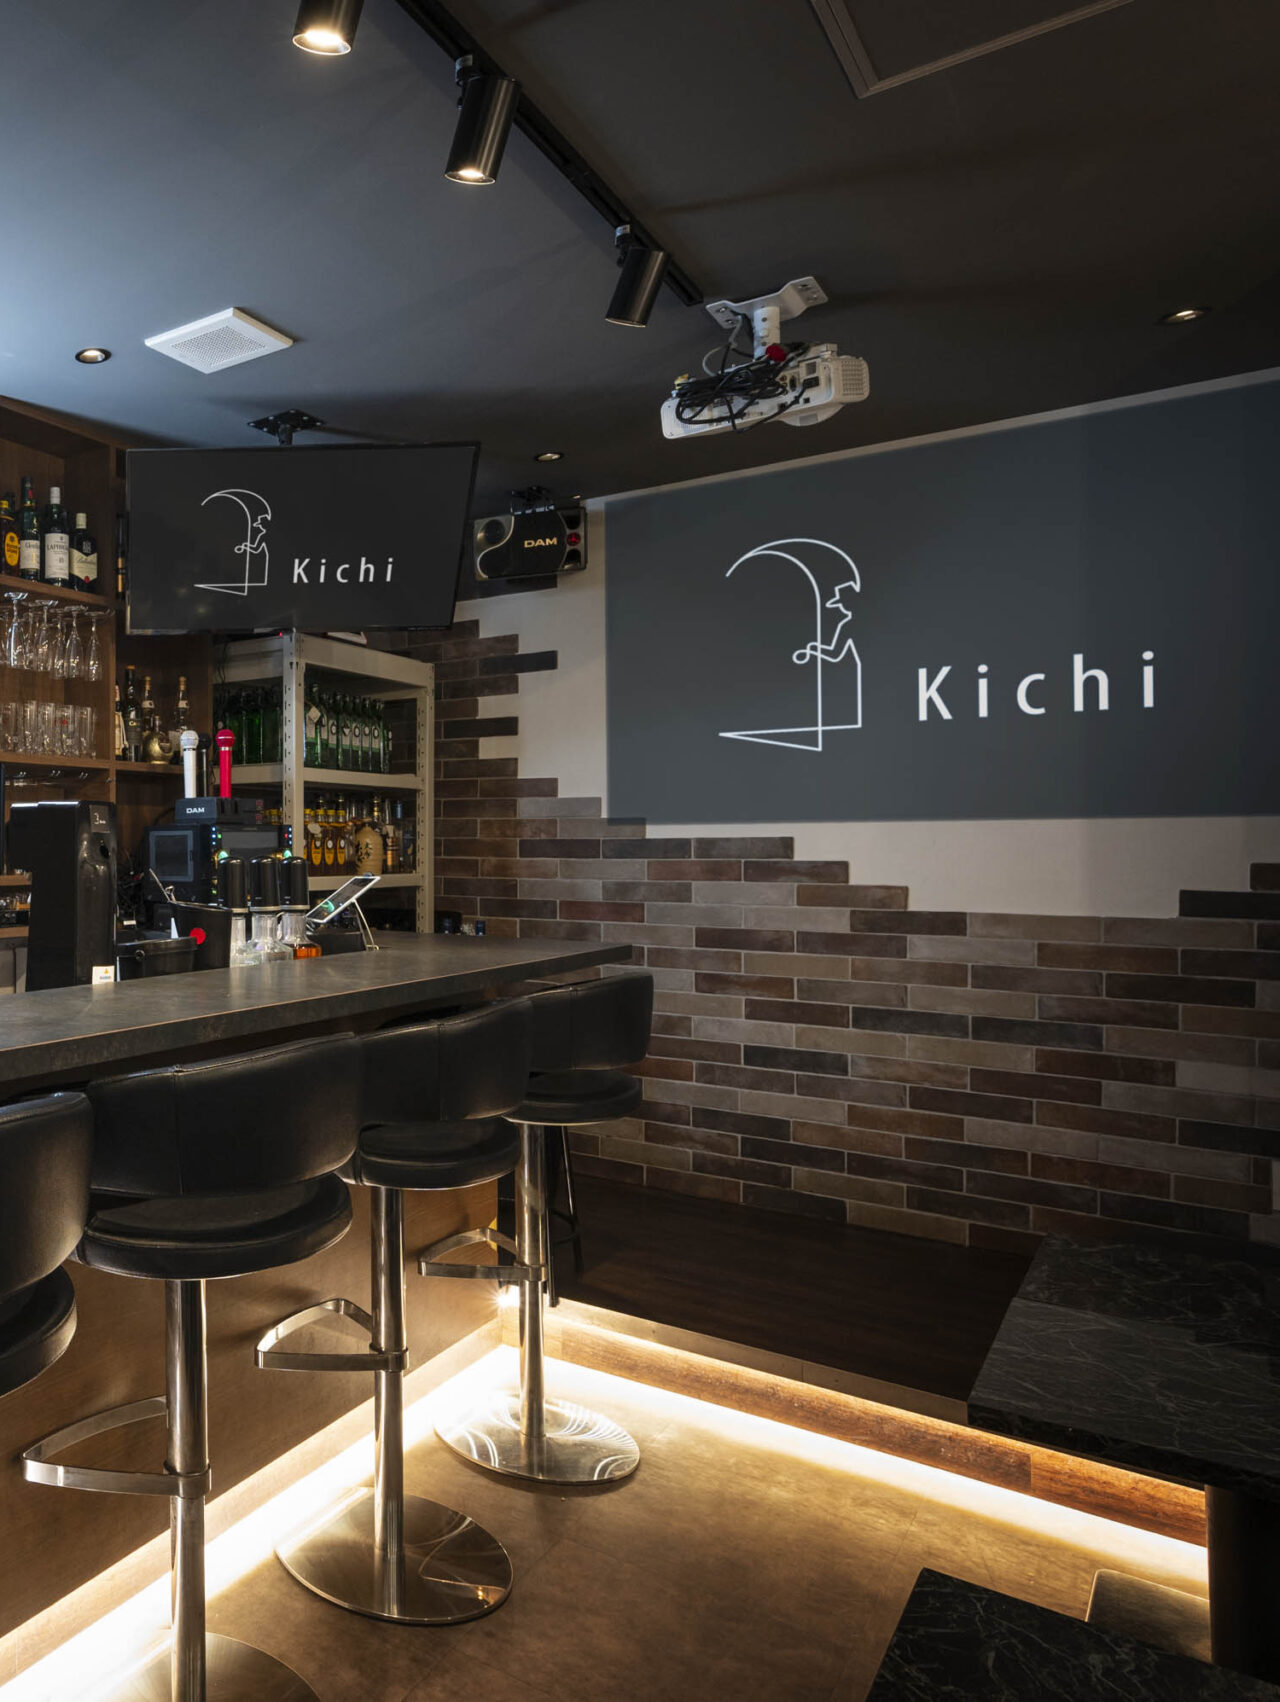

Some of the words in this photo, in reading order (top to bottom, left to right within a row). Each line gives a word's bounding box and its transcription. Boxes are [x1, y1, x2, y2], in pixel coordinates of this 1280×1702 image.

[524, 537, 558, 548] DAM
[293, 557, 393, 584] Kichi
[918, 650, 1155, 721] Kichi
